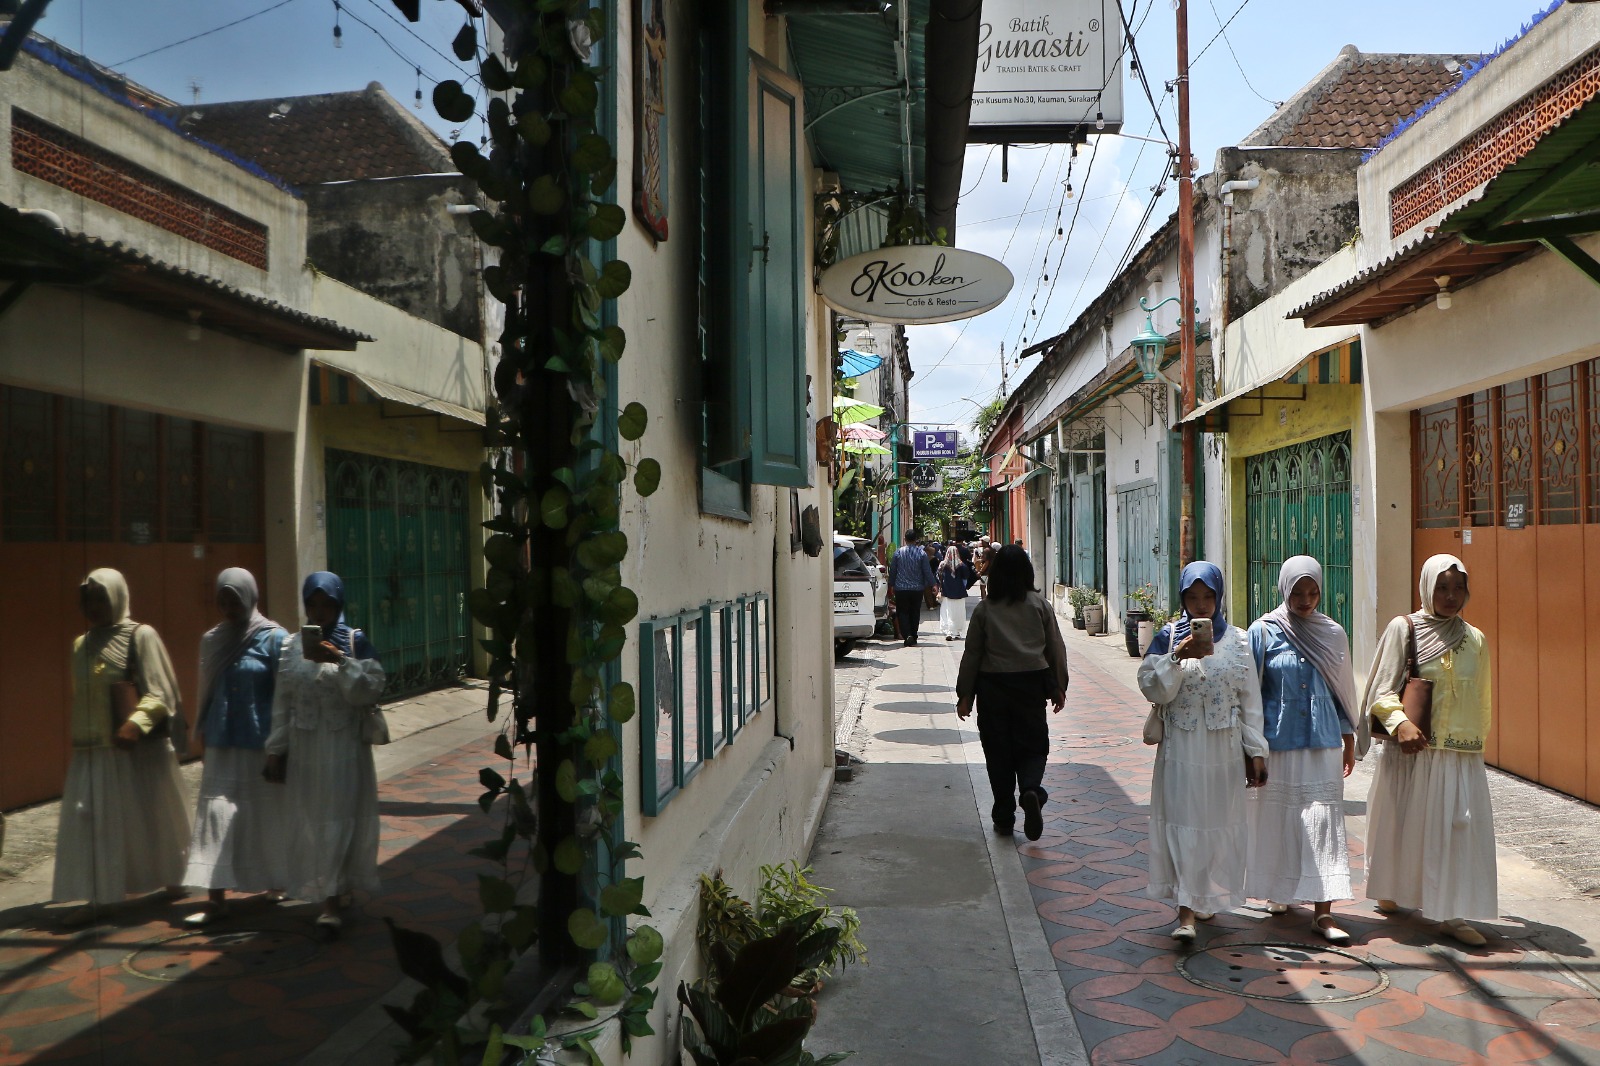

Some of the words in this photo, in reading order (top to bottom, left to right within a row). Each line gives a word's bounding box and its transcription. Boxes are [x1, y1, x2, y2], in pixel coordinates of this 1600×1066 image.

[1009, 15, 1053, 35] Batik
[978, 23, 1090, 72] Gunasti
[1027, 65, 1048, 73] BATIK
[1050, 65, 1057, 73] &
[1058, 64, 1081, 72] CRAFT
[985, 96, 1012, 104] Kusuma
[1013, 96, 1036, 104] No.30,
[1037, 96, 1066, 104] Kauman,
[906, 298, 925, 306] Cafe
[927, 298, 934, 306] &
[937, 298, 957, 306] Resto
[926, 435, 935, 449] P
